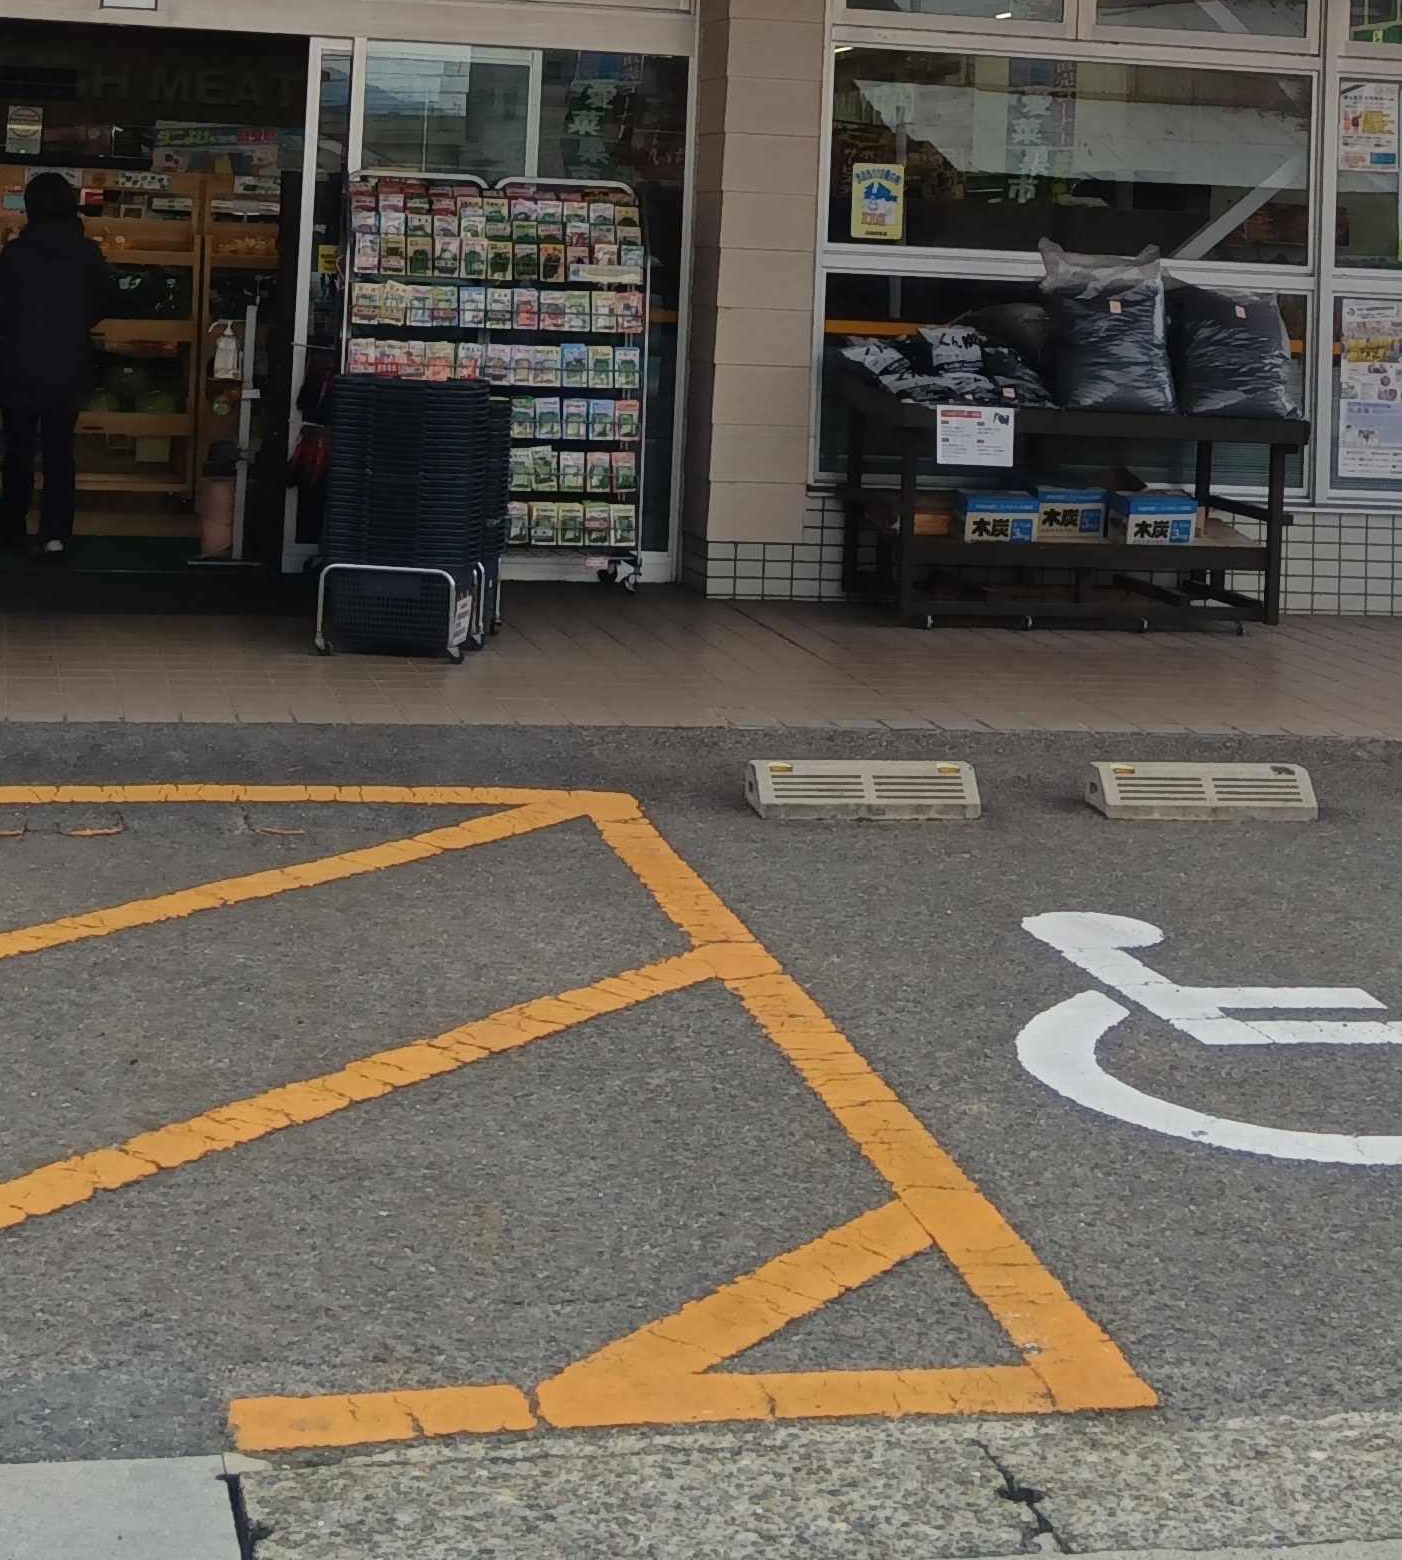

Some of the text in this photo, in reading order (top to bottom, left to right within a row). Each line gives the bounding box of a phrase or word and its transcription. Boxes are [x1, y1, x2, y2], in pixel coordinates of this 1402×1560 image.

[148, 64, 305, 109] MEAT
[1042, 507, 1079, 527] 木炭
[972, 518, 1010, 538] 木炭
[1133, 520, 1171, 539] 木炭
